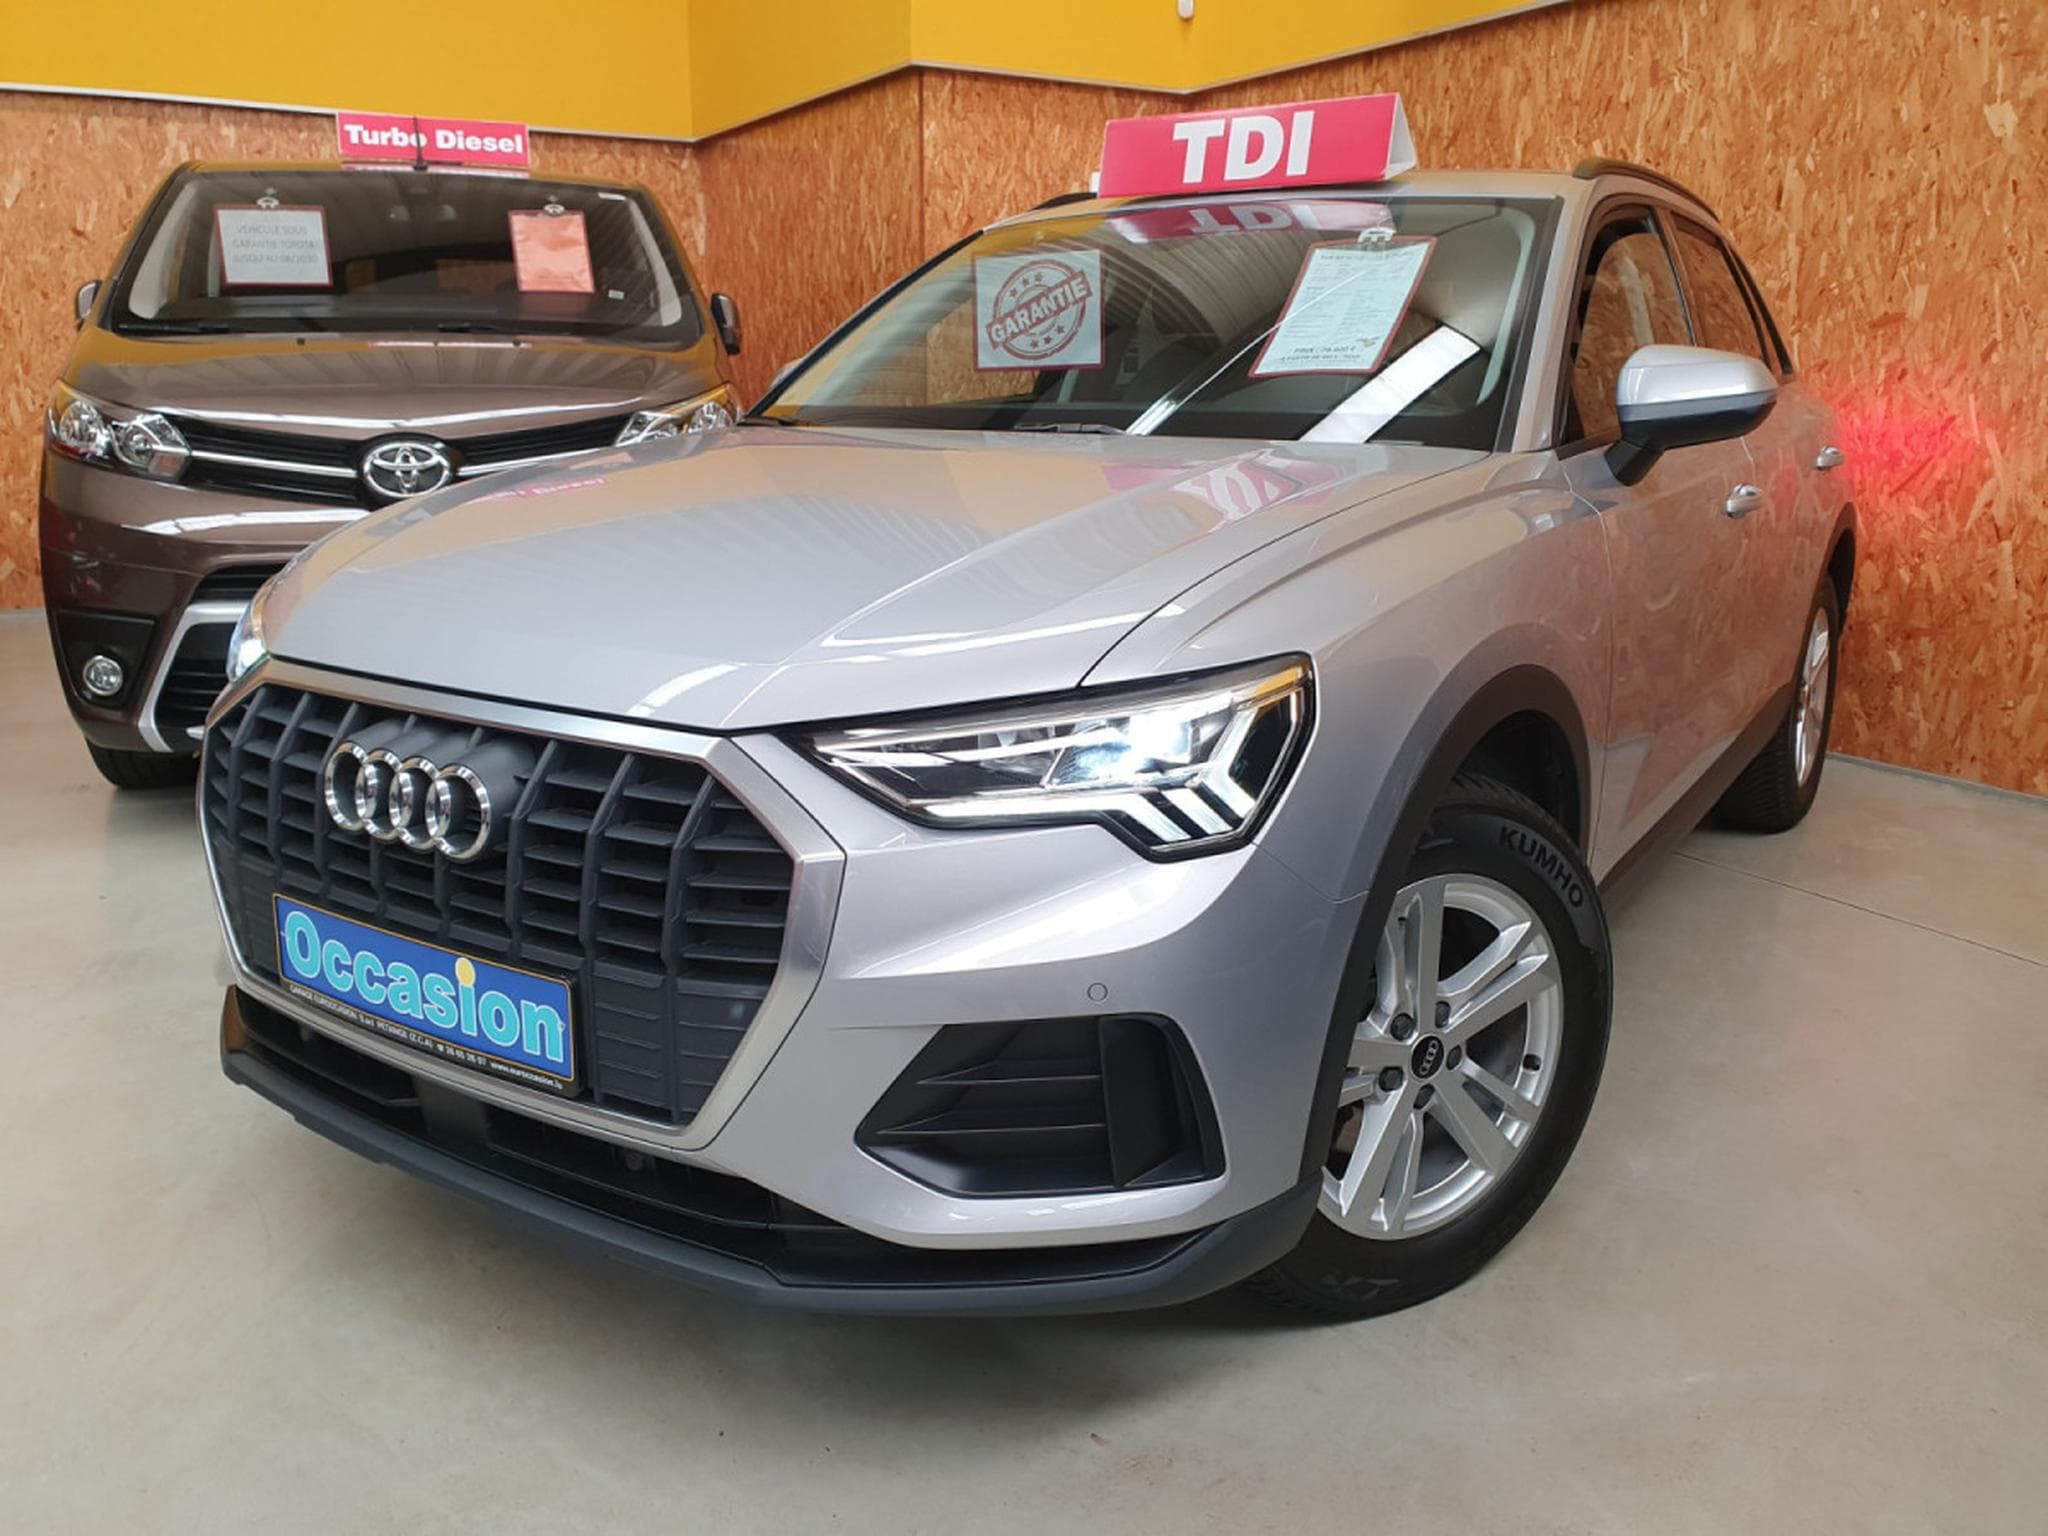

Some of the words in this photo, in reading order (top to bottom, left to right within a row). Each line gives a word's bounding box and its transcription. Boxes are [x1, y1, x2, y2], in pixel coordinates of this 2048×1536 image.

[343, 124, 427, 147] Turbo
[435, 129, 523, 154] Diesel
[1173, 110, 1315, 184] TDI
[281, 239, 316, 250] TOYOTA
[991, 277, 1088, 344] GARANTIE
[1501, 826, 1584, 908] KUMHO
[284, 910, 564, 1063] Occasion
